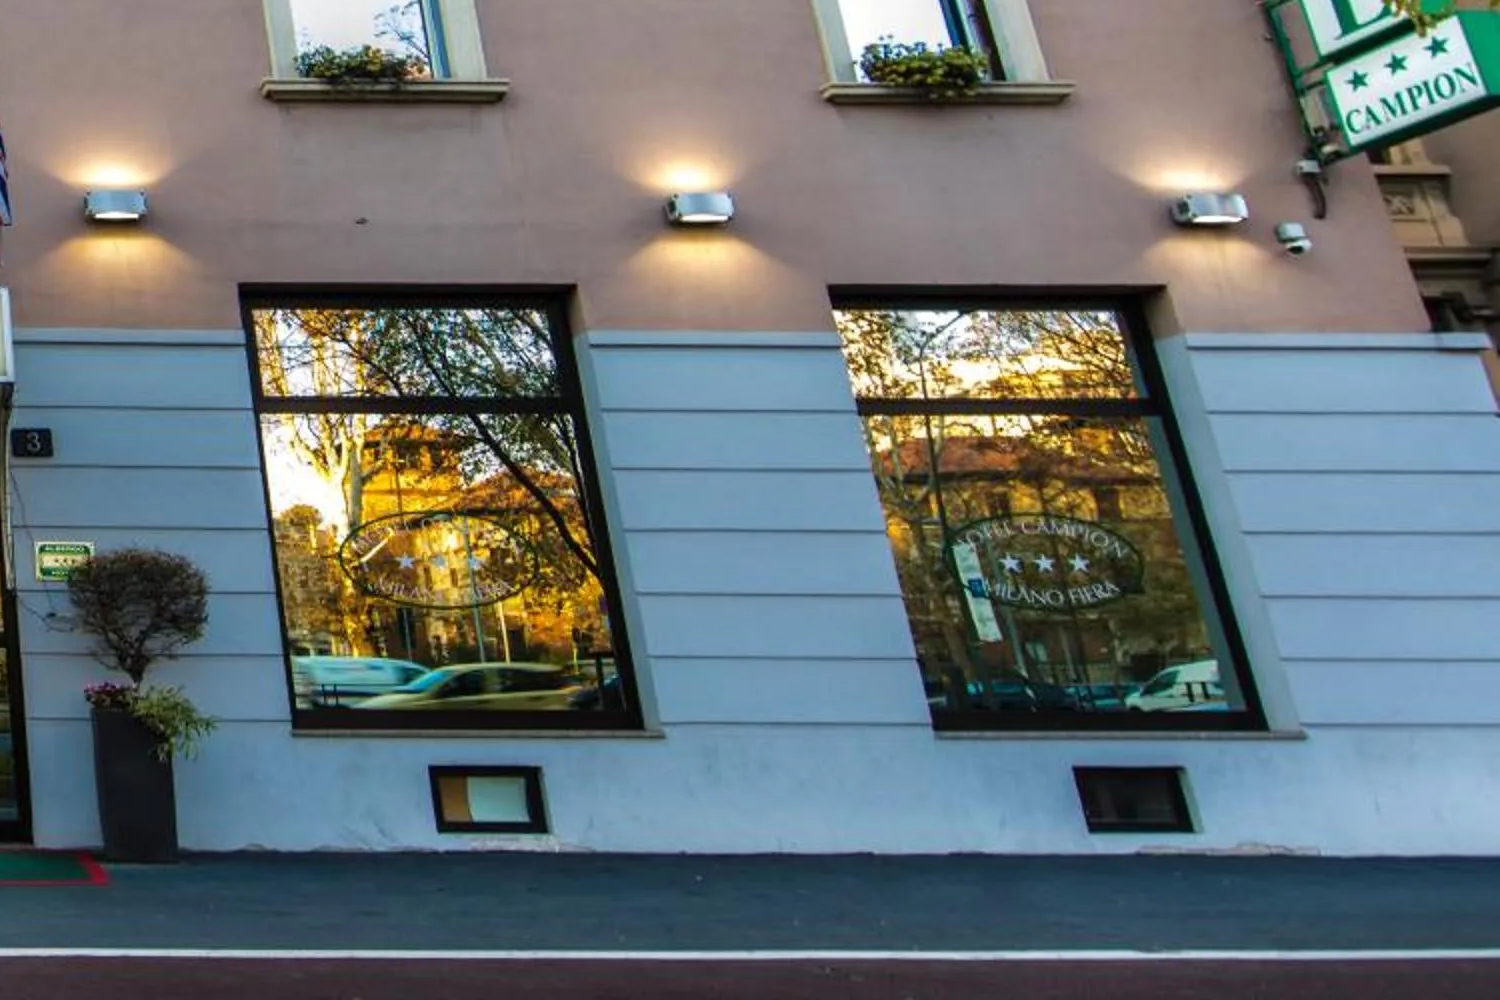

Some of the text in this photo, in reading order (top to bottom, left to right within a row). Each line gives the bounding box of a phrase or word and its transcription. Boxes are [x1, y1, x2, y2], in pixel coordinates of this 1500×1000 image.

[1345, 62, 1479, 135] CAMPION
[26, 431, 41, 451] 3
[1021, 520, 1128, 558] CAMPION
[985, 579, 1120, 604] MILANO FIERA
